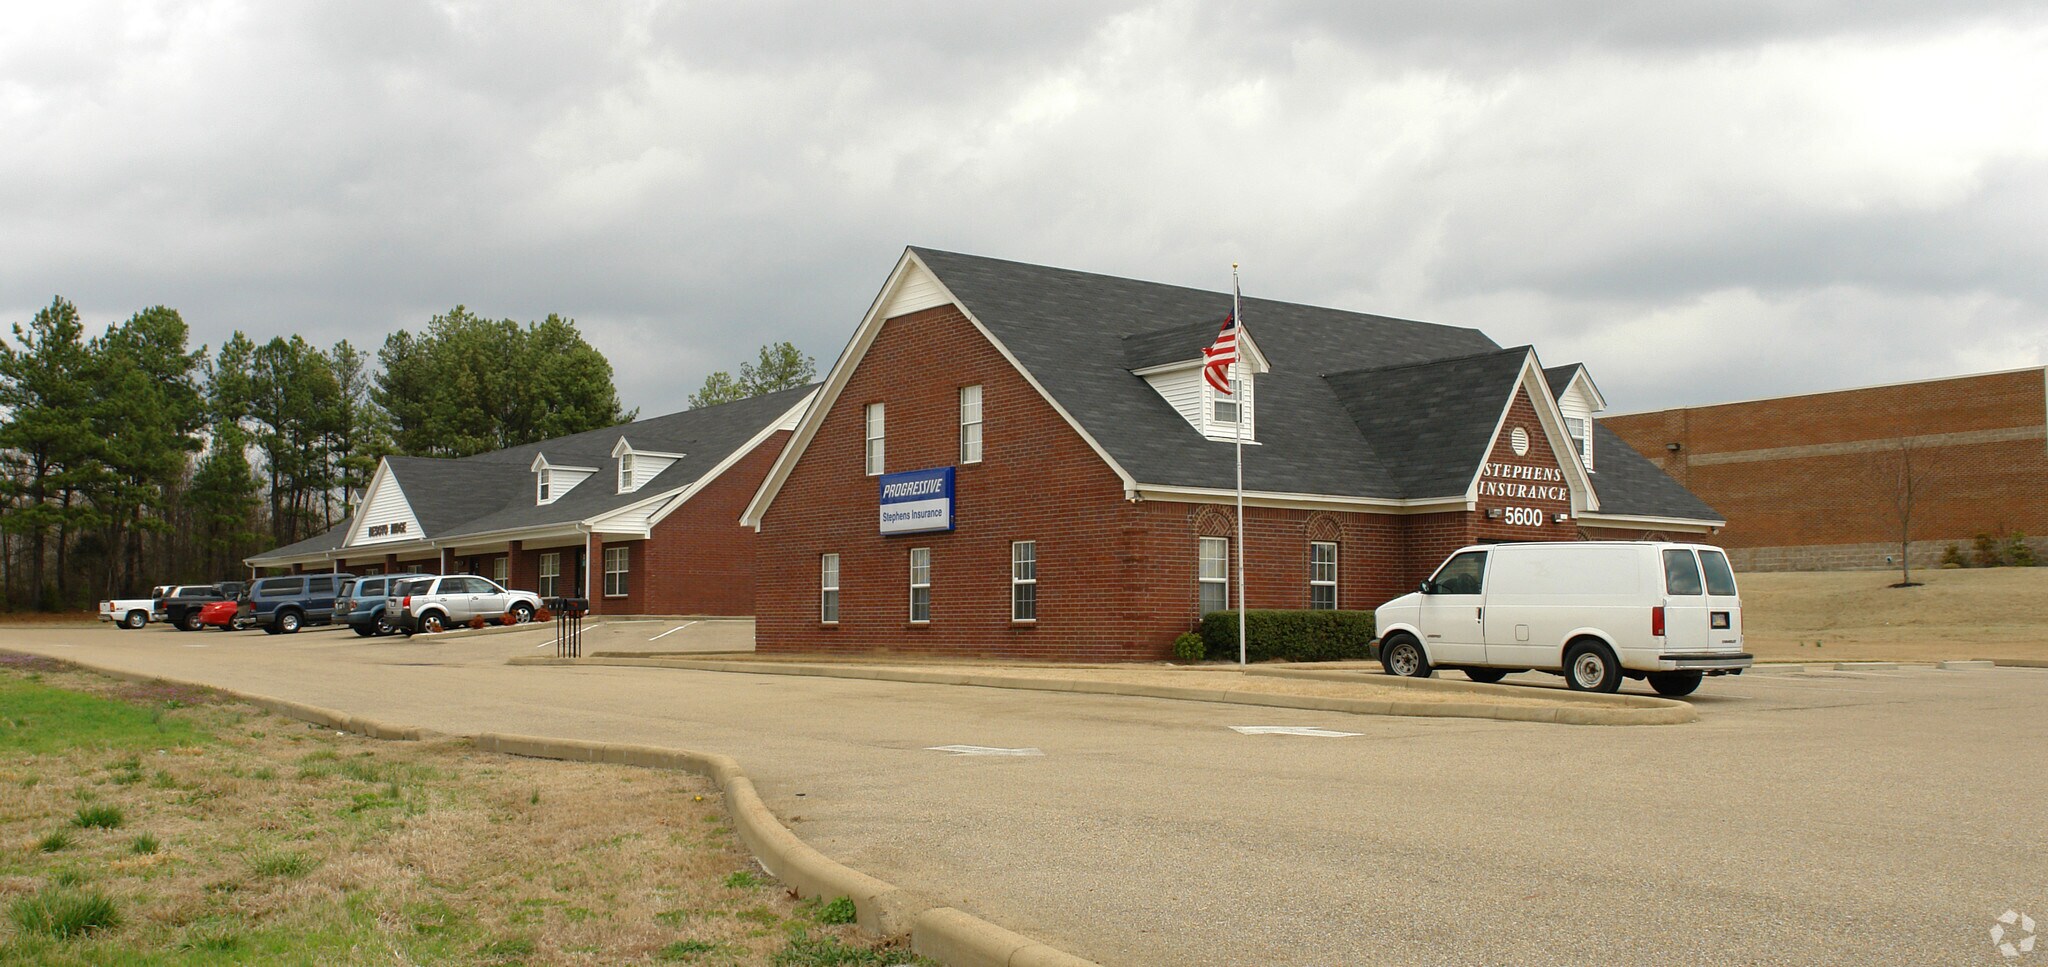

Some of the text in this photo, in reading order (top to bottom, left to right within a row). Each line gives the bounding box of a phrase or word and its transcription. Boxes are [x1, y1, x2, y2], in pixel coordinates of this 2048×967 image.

[1483, 463, 1561, 482] STEPHENS
[882, 478, 943, 499] PROGRESSIVE
[1478, 481, 1567, 501] INSURANCE
[882, 508, 943, 523] Stephens Insurance
[1504, 506, 1543, 527] 5600
